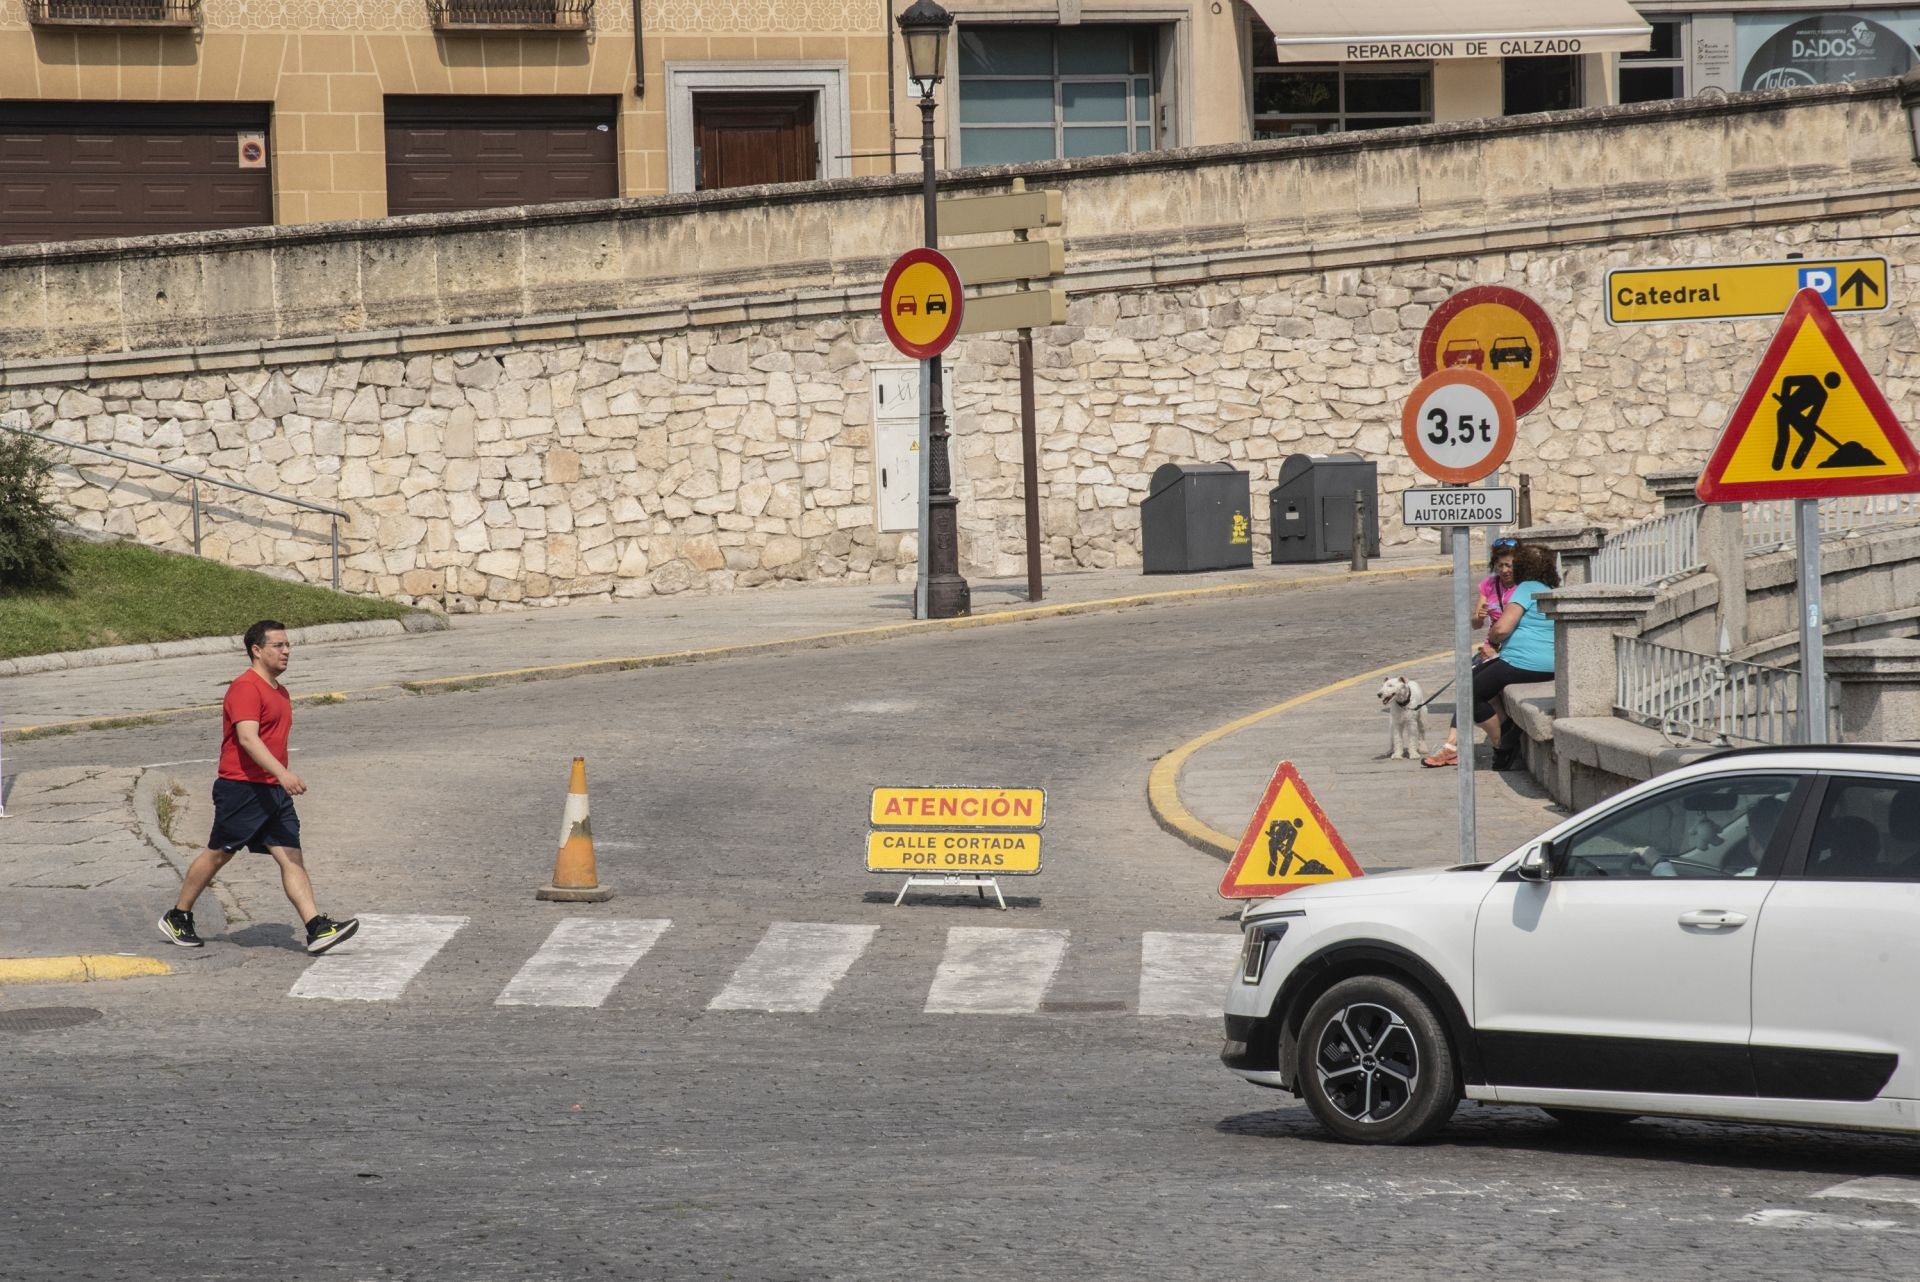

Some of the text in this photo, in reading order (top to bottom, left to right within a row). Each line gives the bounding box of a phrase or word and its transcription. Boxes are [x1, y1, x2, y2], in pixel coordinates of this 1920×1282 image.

[1346, 39, 1582, 59] REPARACION DE CALZADO
[1806, 271, 1832, 294] P
[1617, 283, 1721, 307] Catedral
[1430, 493, 1486, 506] EXCEPTO
[1414, 507, 1503, 521] AUTORIZADOS
[884, 792, 1033, 817] ATENCIÓN
[882, 836, 1026, 850] CALLE CORTADA
[902, 852, 1005, 866] POR OBRAS
